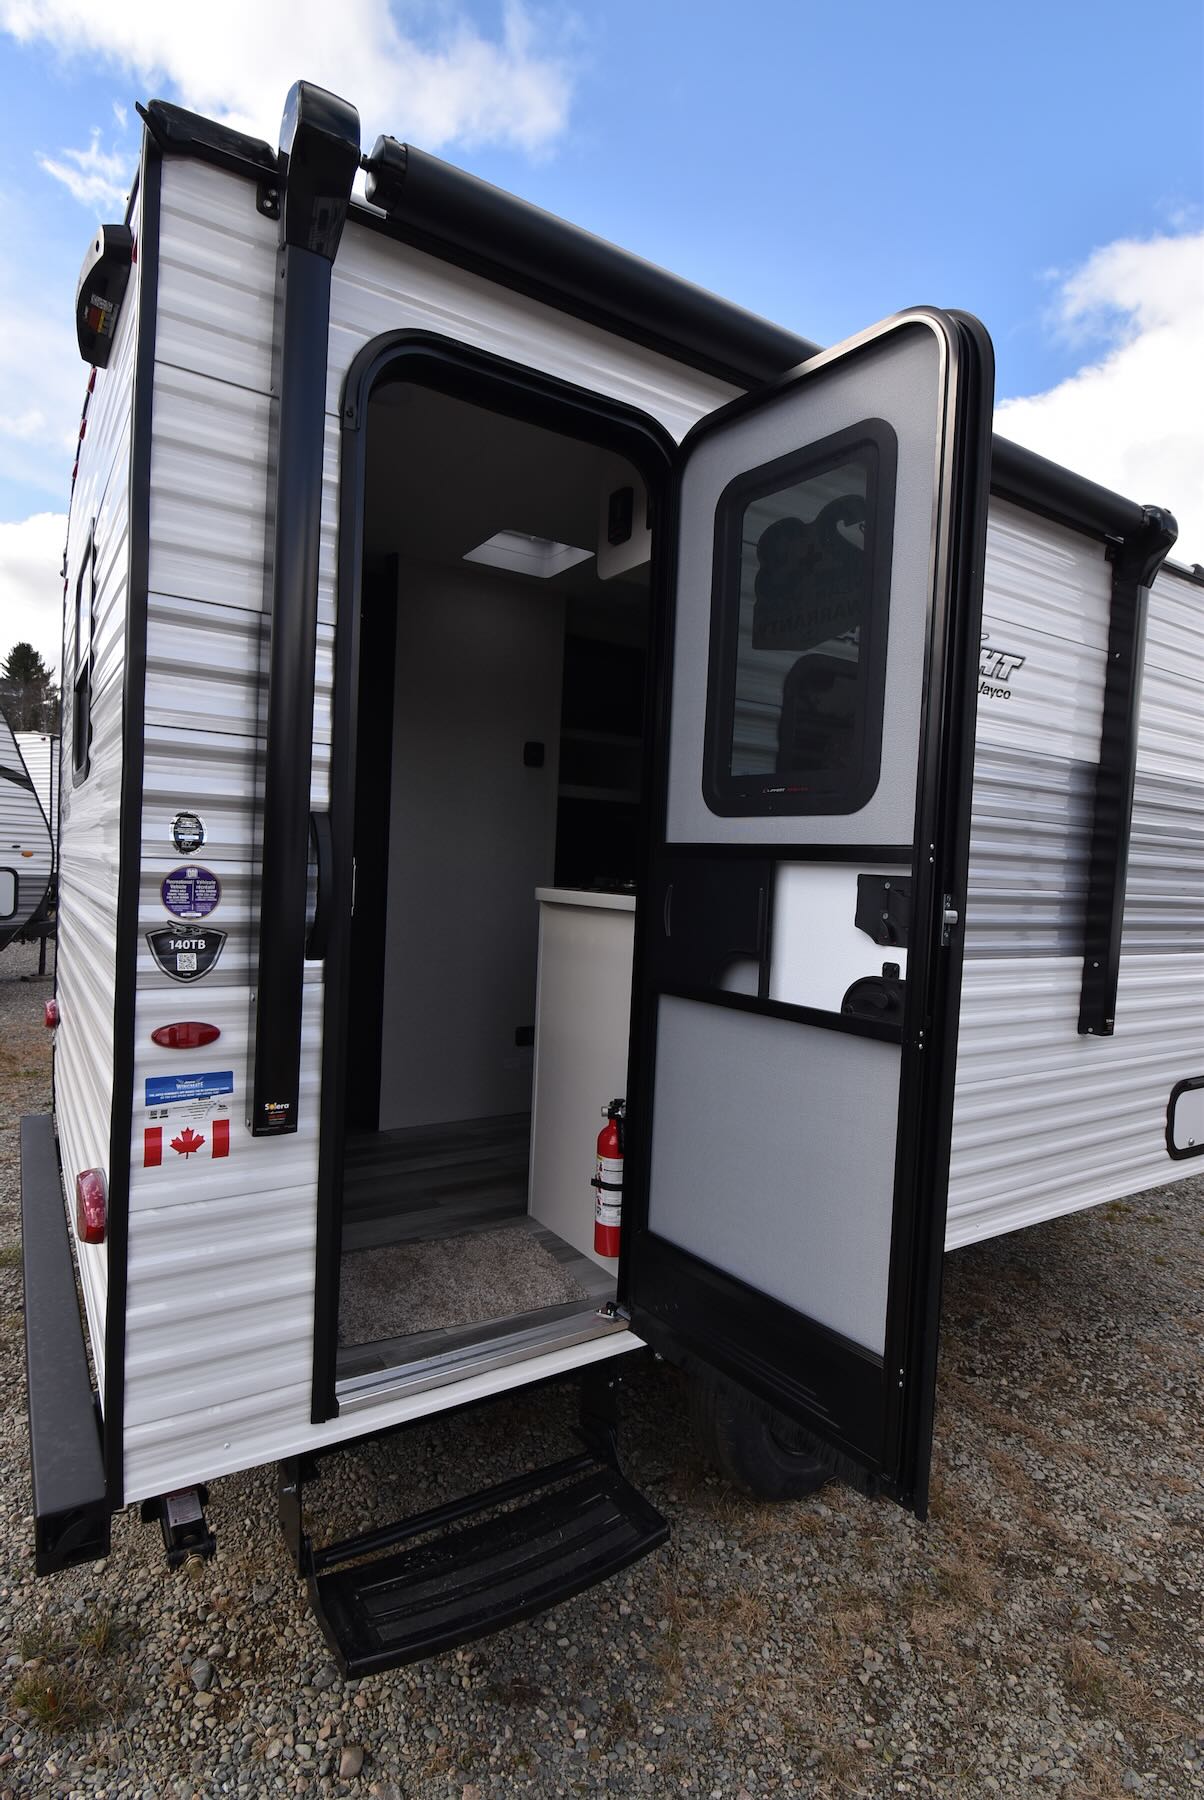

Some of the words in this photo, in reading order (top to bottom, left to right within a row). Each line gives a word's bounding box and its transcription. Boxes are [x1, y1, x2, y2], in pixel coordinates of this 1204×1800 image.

[977, 681, 1011, 699] Jayco
[169, 939, 206, 950] 140TB
[264, 1102, 290, 1111] Solera
